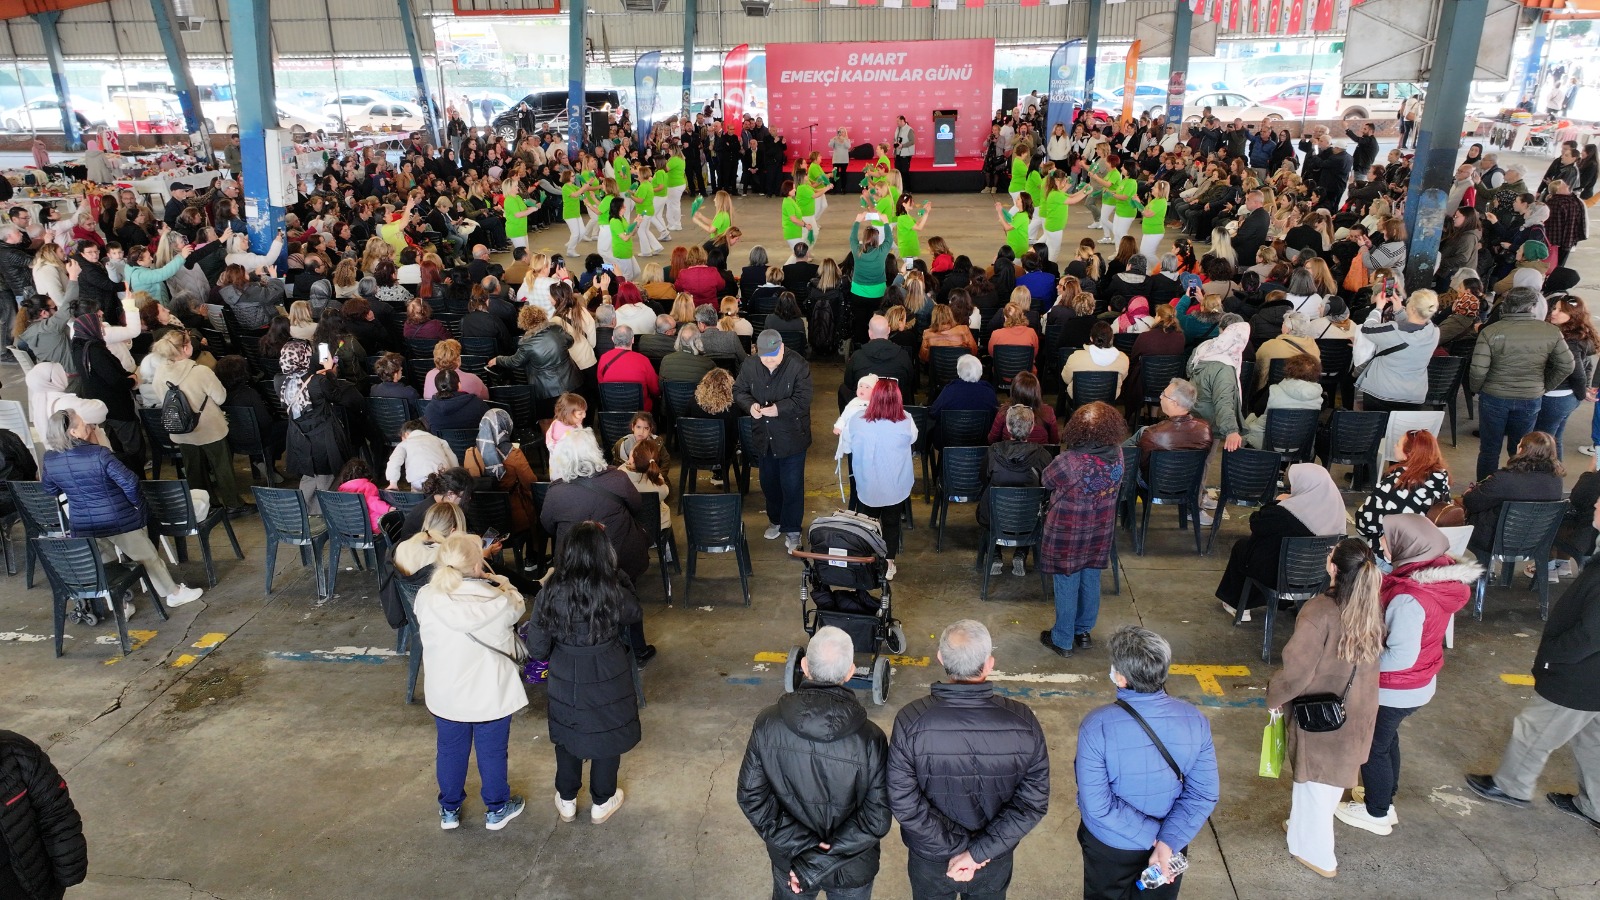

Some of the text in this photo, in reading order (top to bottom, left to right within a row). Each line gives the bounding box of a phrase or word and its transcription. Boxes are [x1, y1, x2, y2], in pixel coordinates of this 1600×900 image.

[848, 52, 907, 66] 8 MART
[781, 64, 972, 87] EMEKÇİ KADINLAR GÜNÜ
